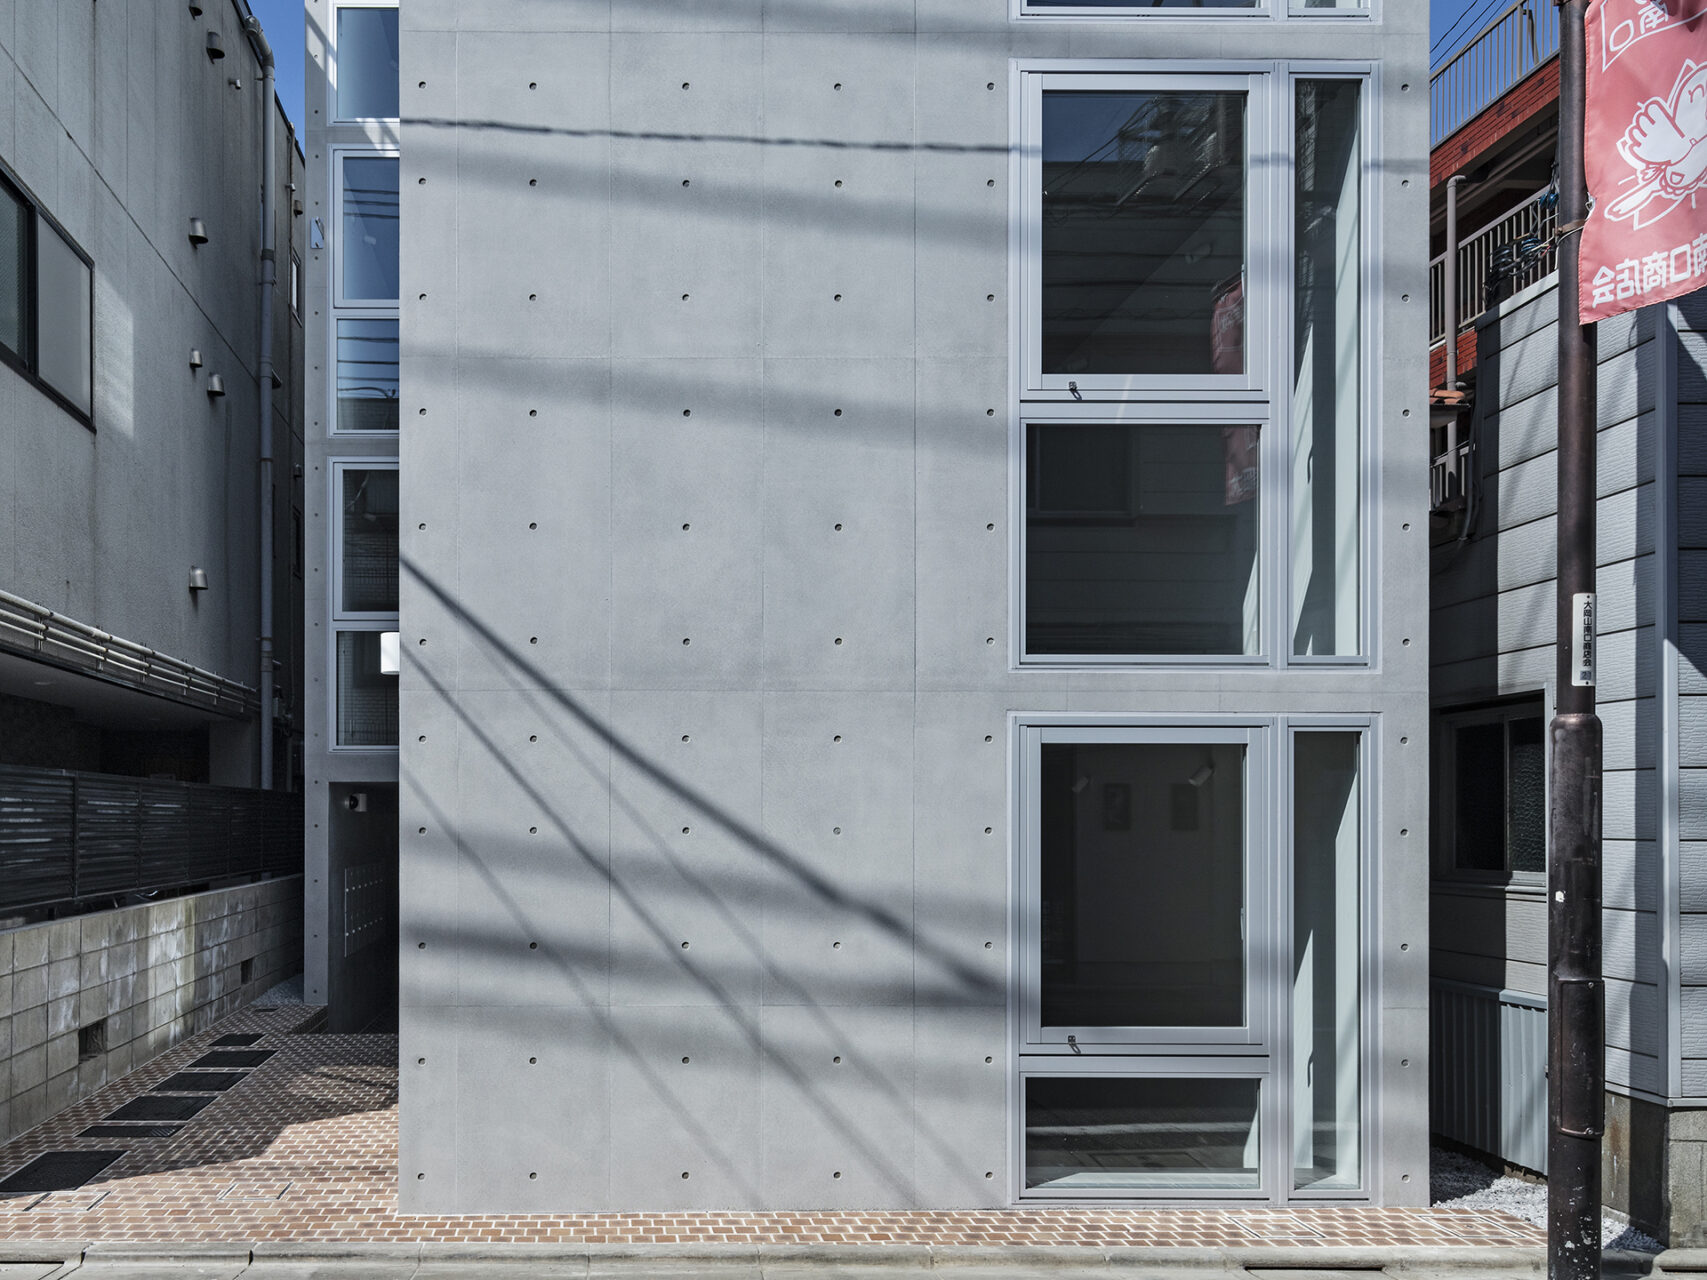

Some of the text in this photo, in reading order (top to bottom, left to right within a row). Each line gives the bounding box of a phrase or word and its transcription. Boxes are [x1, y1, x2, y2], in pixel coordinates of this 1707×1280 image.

[1583, 601, 1592, 667] 大岡山南口商店会
